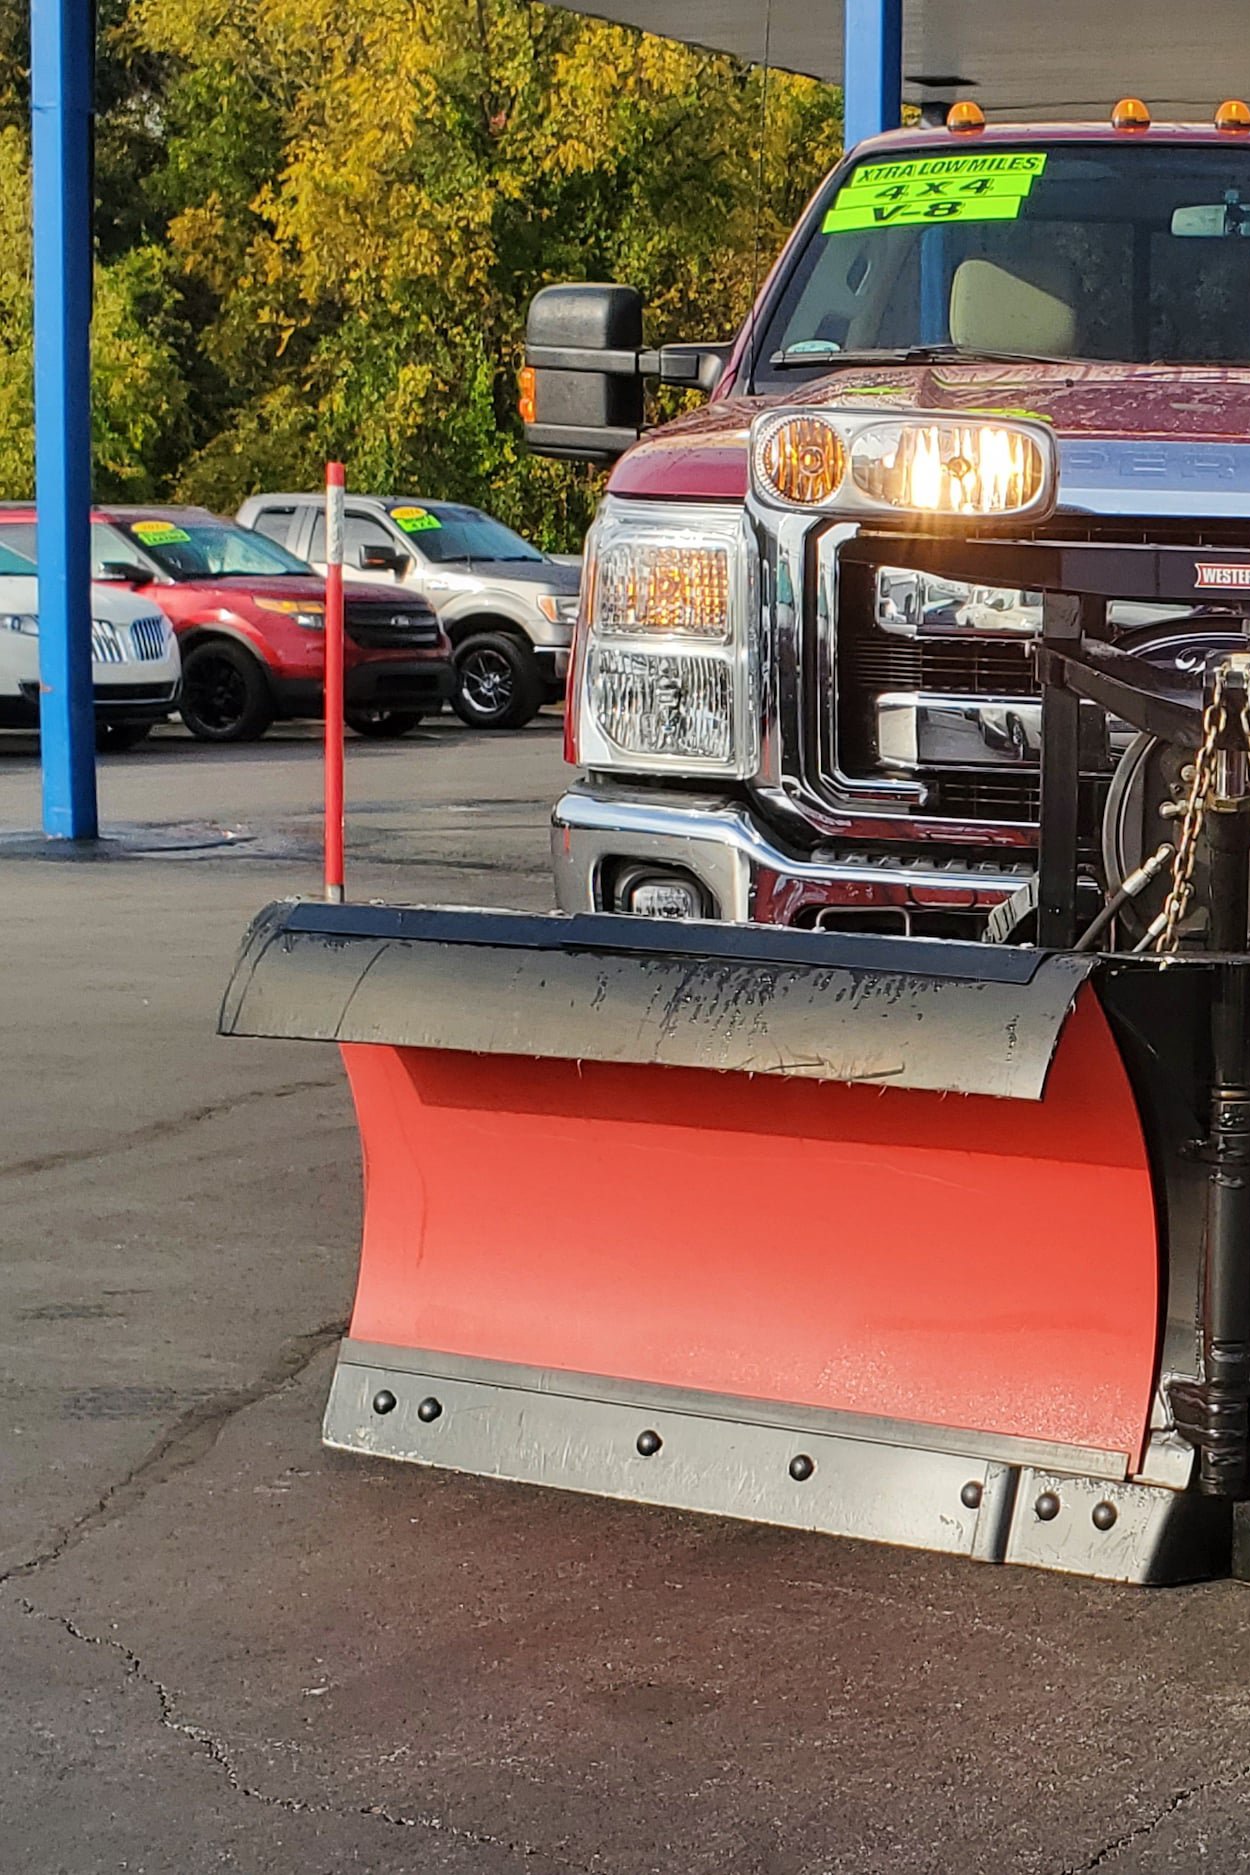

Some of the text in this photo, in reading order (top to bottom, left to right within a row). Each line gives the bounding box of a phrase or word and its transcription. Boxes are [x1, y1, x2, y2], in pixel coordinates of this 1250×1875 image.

[857, 156, 1039, 183] XTRA LOW MILES
[873, 201, 963, 221] V-8
[1058, 450, 1237, 478] PER
